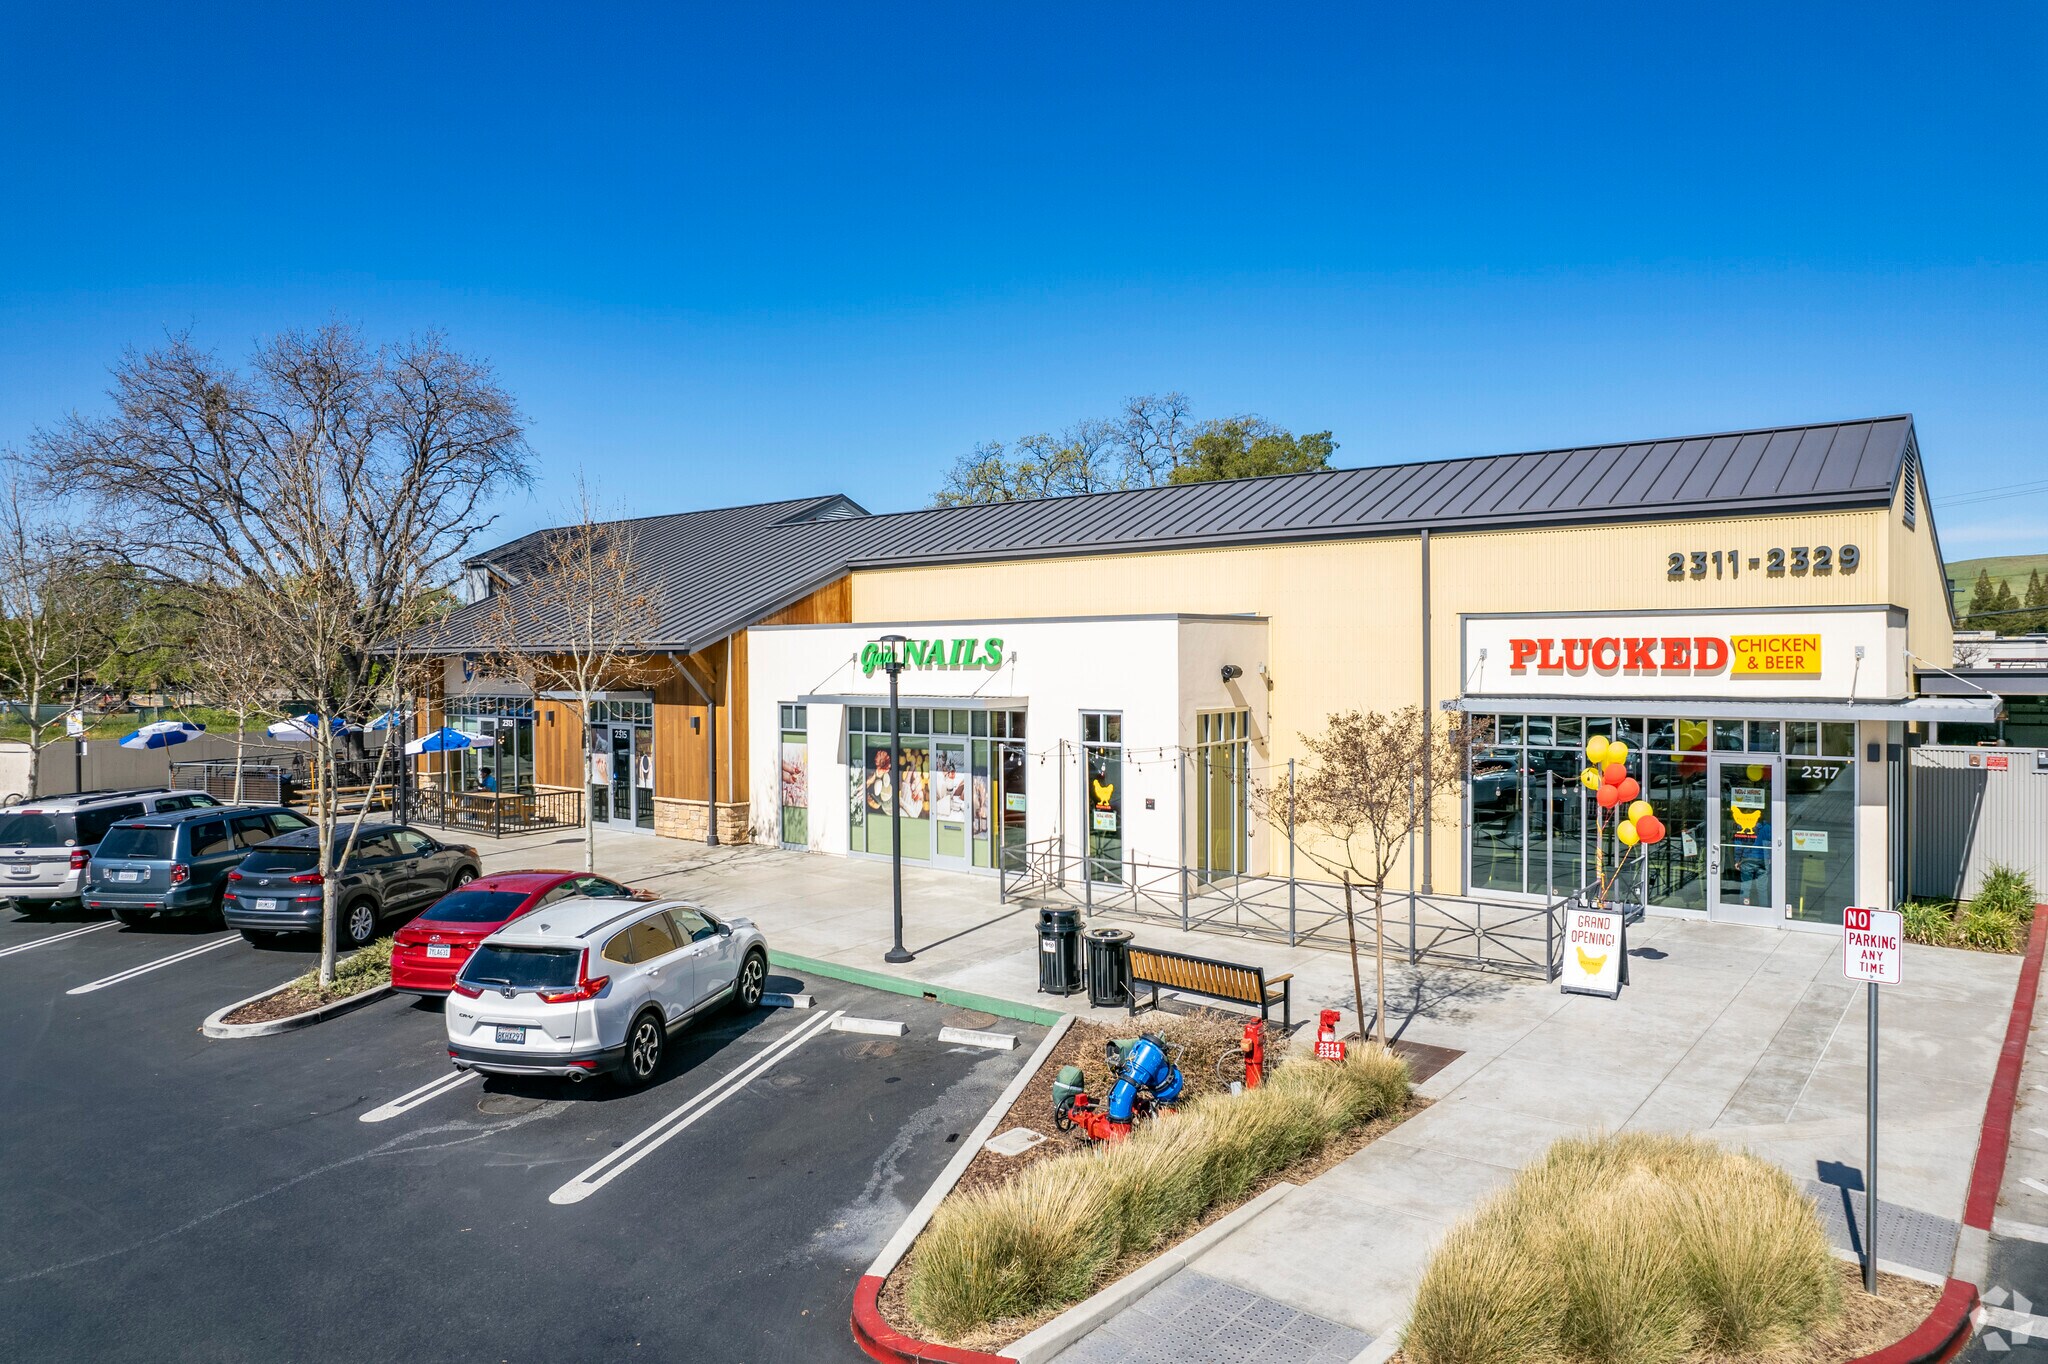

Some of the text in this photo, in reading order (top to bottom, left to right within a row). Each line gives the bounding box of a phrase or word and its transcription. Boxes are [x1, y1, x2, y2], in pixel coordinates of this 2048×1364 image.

[1667, 544, 1860, 578] 2311-2329
[904, 637, 1003, 666] NAILS
[1737, 637, 1817, 653] CHICKEN
[1509, 637, 1729, 671] PLUCKED
[1747, 655, 1805, 670] & BEER
[614, 729, 628, 739] 2315
[1801, 765, 1840, 779] 2317
[1577, 915, 1611, 930] GRAND
[1847, 910, 1868, 928] NO
[1571, 930, 1615, 946] OPENING!
[1849, 932, 1896, 950] PARKING
[1861, 949, 1883, 961] ANY
[1860, 961, 1885, 974] TIME
[1319, 1042, 1340, 1050] 2311
[1317, 1050, 1340, 1058] -2329
